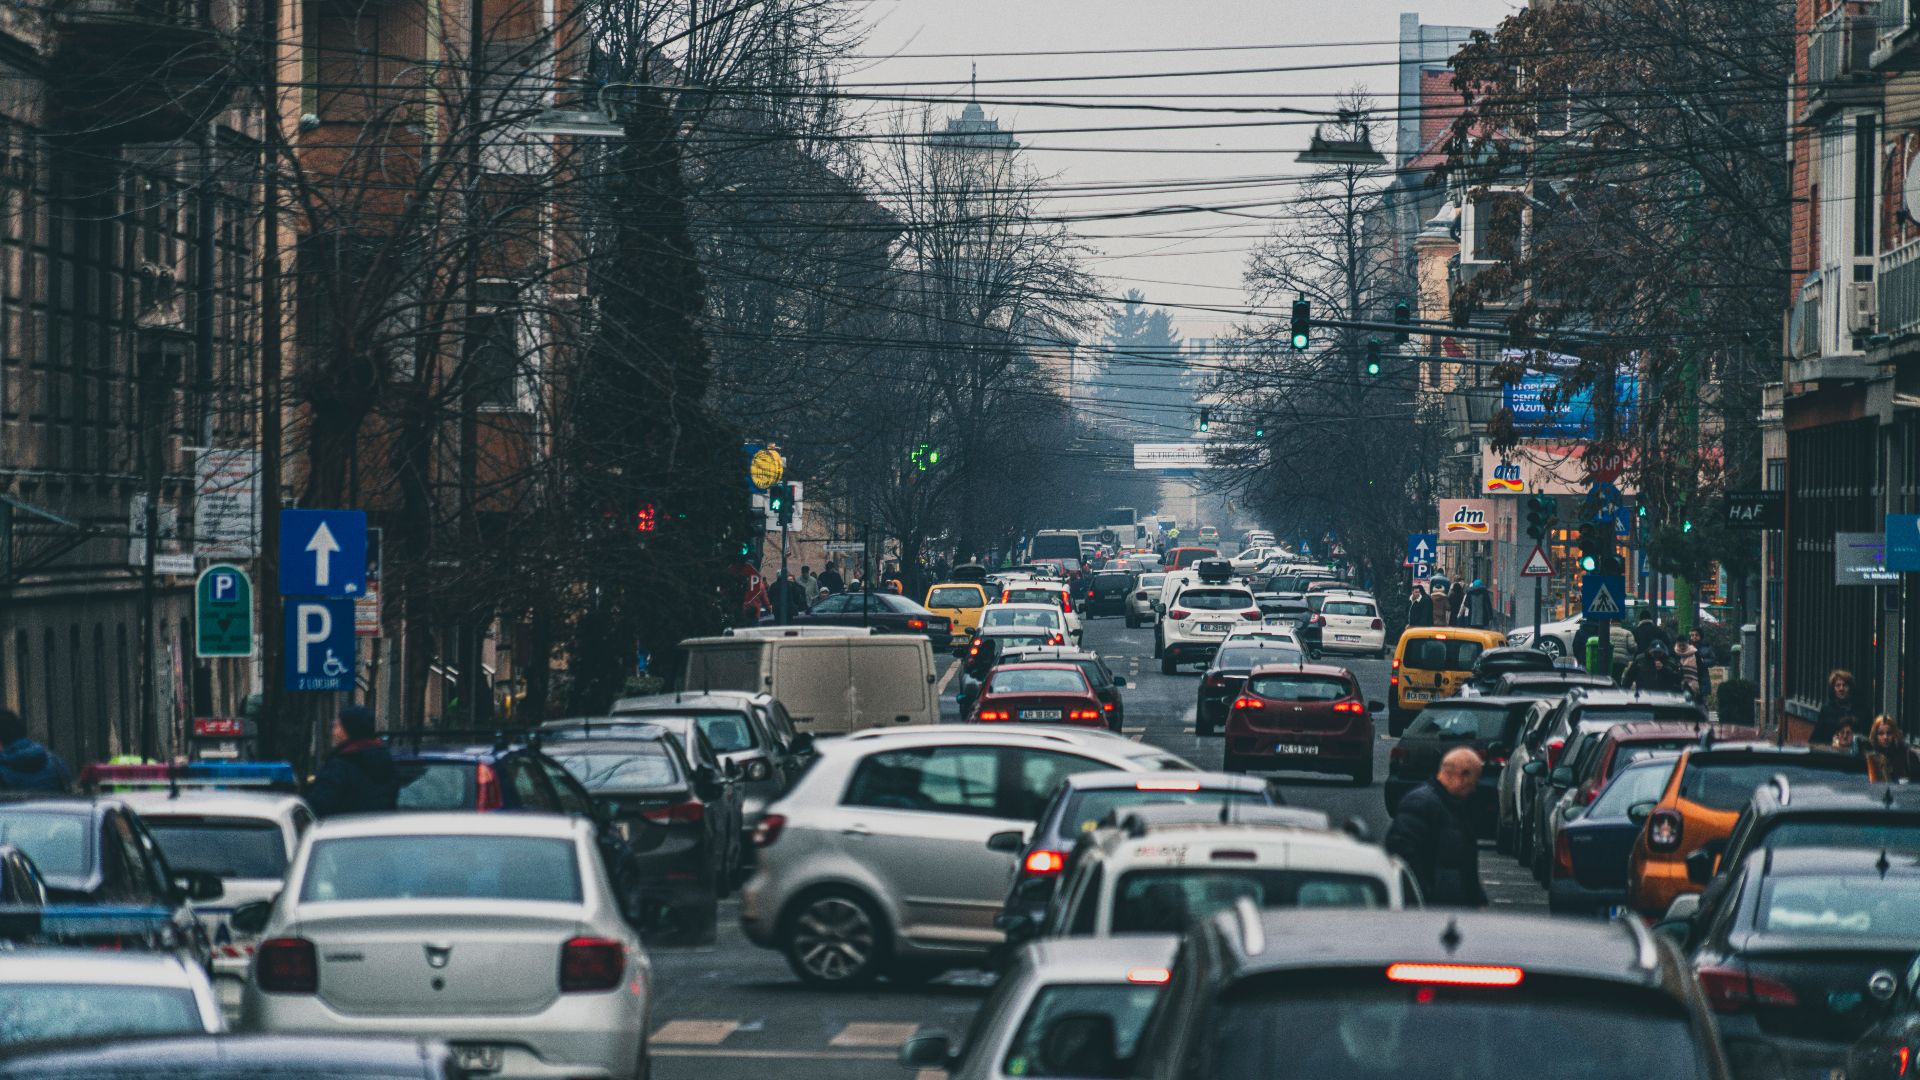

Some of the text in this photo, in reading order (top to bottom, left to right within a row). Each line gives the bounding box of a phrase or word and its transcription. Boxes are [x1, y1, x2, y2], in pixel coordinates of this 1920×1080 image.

[1454, 506, 1484, 523] dm
[1729, 504, 1764, 520] HAF
[1417, 565, 1428, 577] P
[215, 575, 233, 600] P
[297, 603, 333, 674] P
